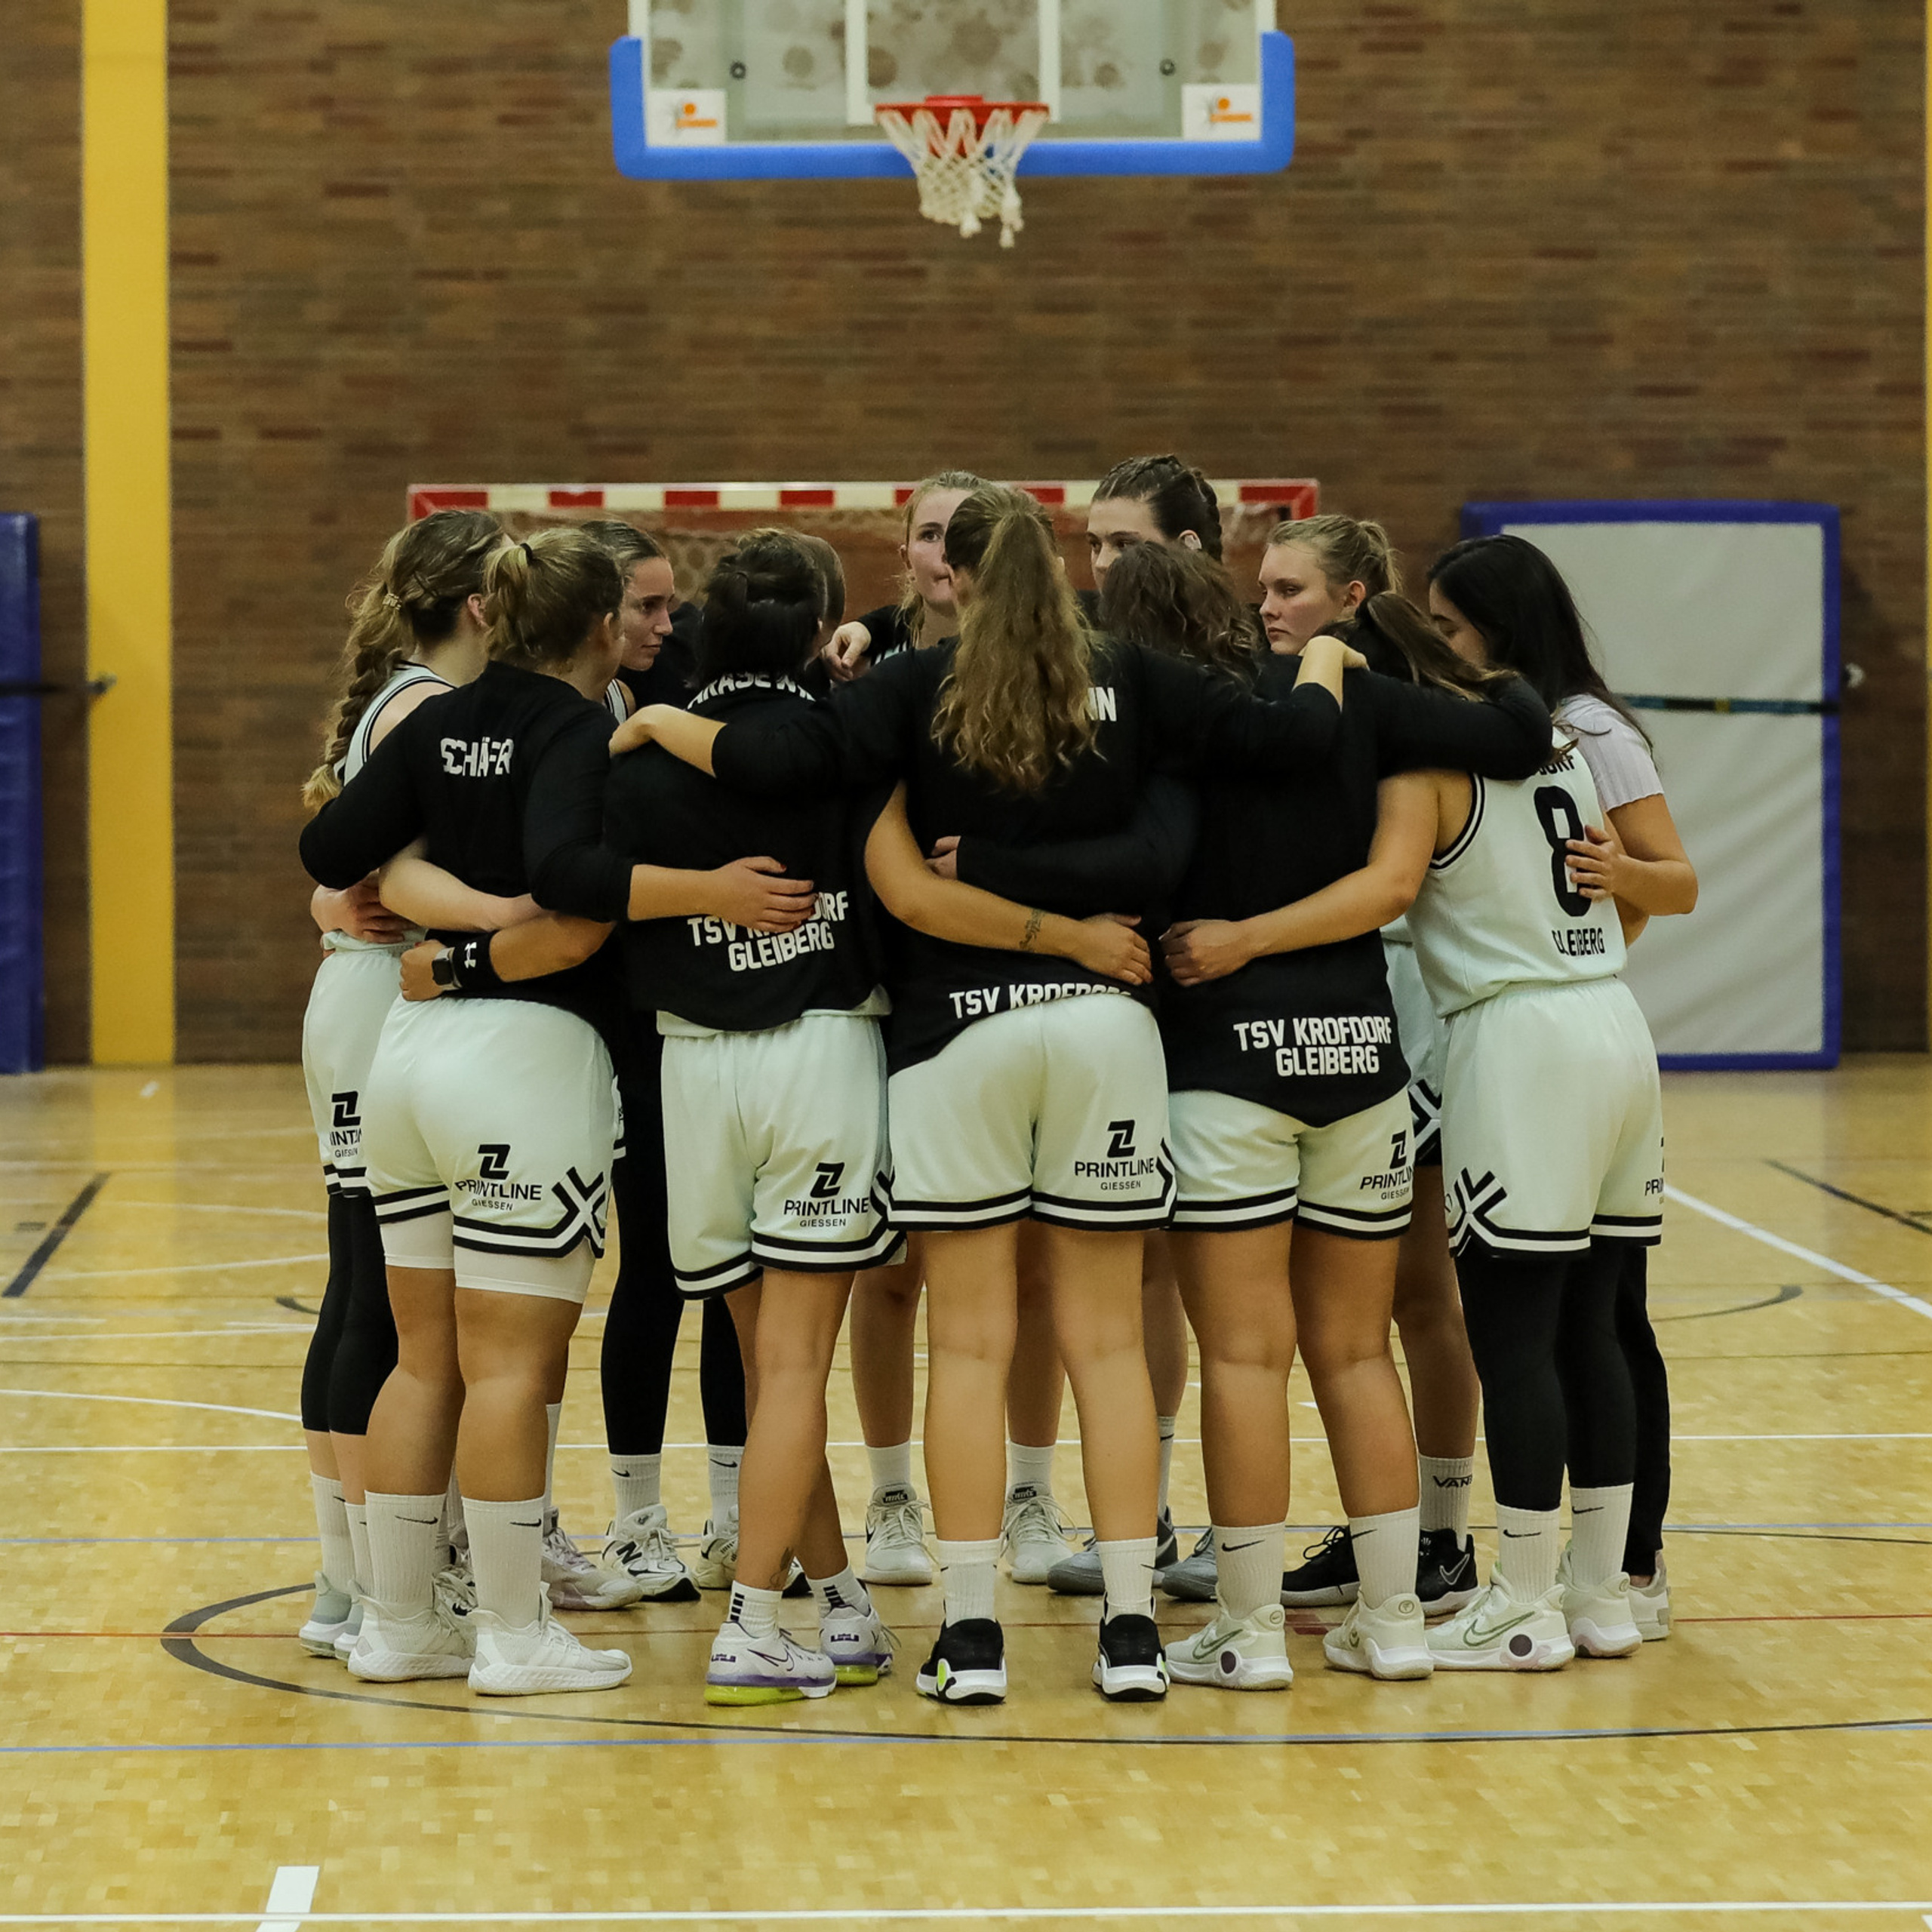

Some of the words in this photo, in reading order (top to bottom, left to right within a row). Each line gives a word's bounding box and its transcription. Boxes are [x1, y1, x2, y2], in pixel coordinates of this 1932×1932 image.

[1534, 786, 1592, 917] 8
[687, 916, 737, 946] TSV
[728, 921, 835, 971] GLEIBERG
[949, 986, 1000, 1019] TSV
[1233, 1019, 1284, 1051] TSV
[1293, 1016, 1392, 1046] KROFDORF
[1275, 1044, 1380, 1077] GLEIBERG
[1075, 1157, 1154, 1177] PRINTLINE
[454, 1179, 543, 1201] PRINTLINE
[1100, 1180, 1141, 1190] GIESSEN
[472, 1198, 513, 1211] GIESSEN
[784, 1197, 869, 1217] PRINTLINE
[800, 1219, 846, 1227] GIESSEN
